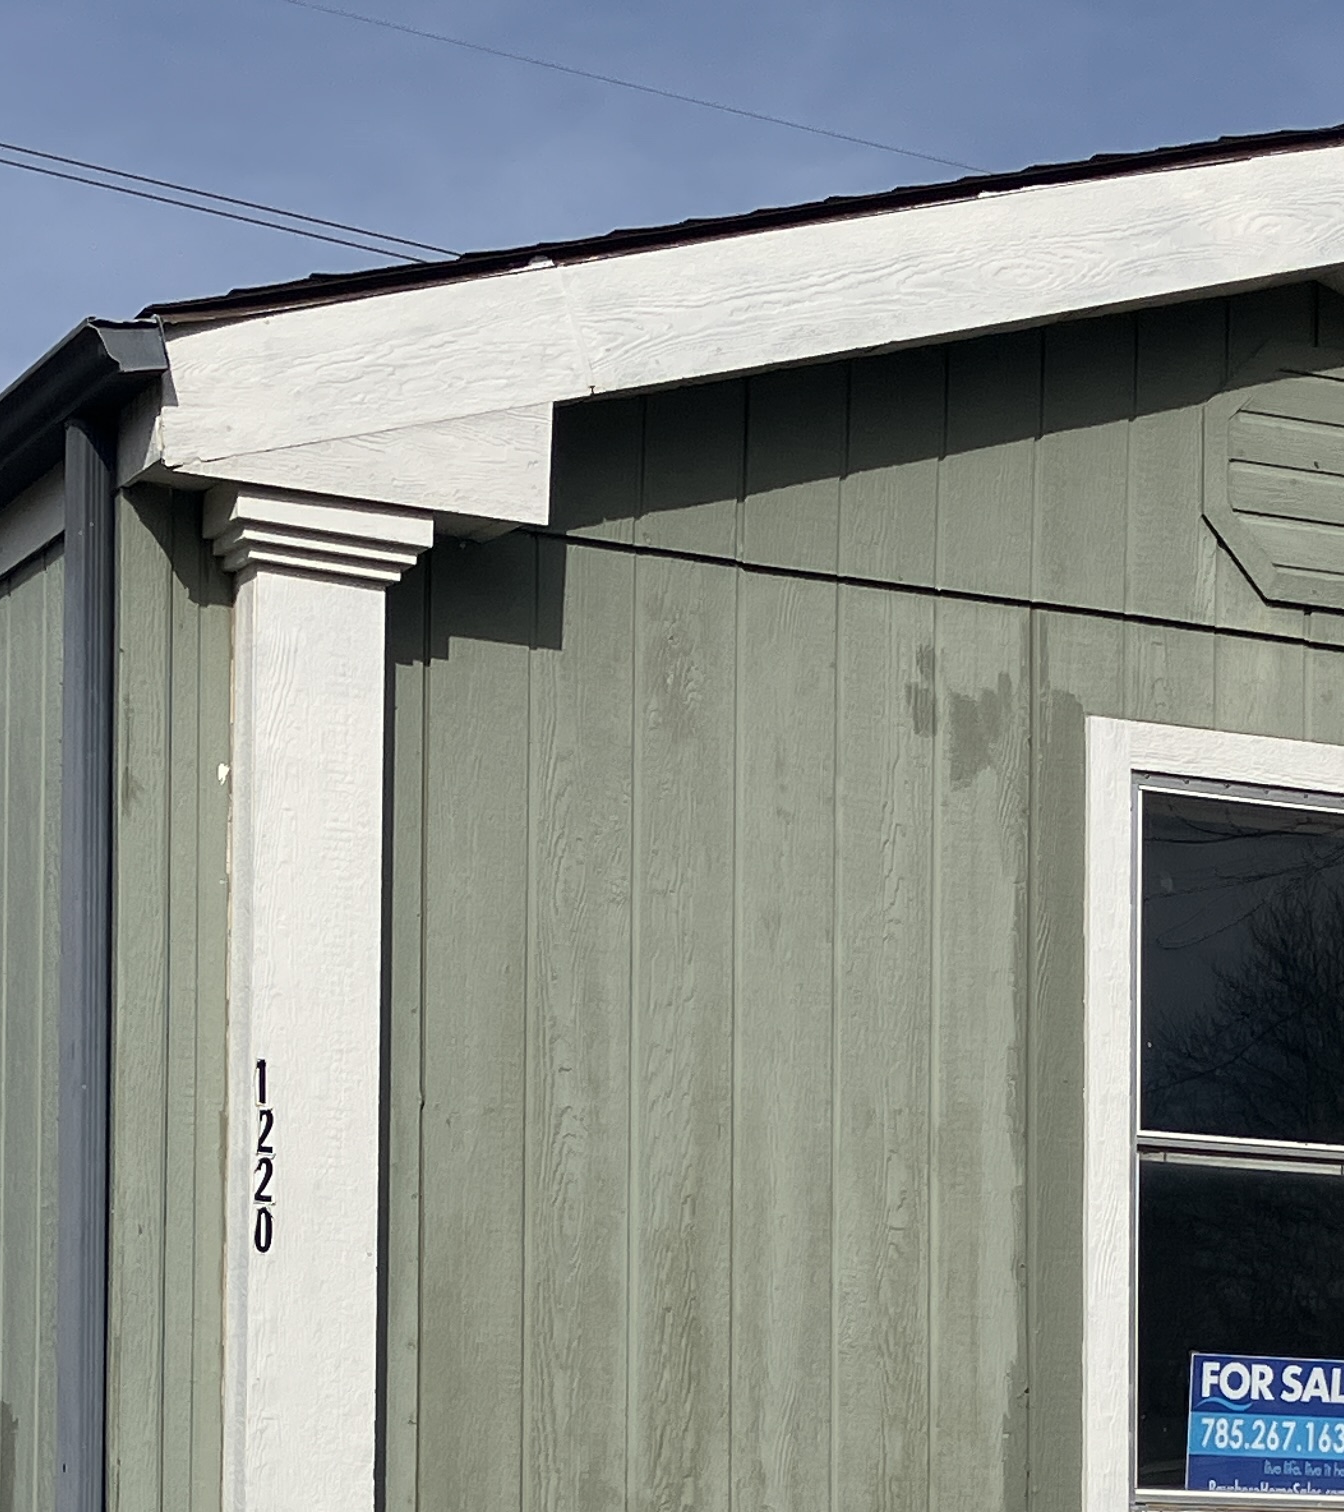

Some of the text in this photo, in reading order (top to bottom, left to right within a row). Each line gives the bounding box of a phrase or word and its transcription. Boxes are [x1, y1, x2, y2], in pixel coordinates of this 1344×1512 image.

[254, 1059, 274, 1253] 1220
[1201, 1361, 1275, 1401] FOR
[1324, 1463, 1332, 1477] it
